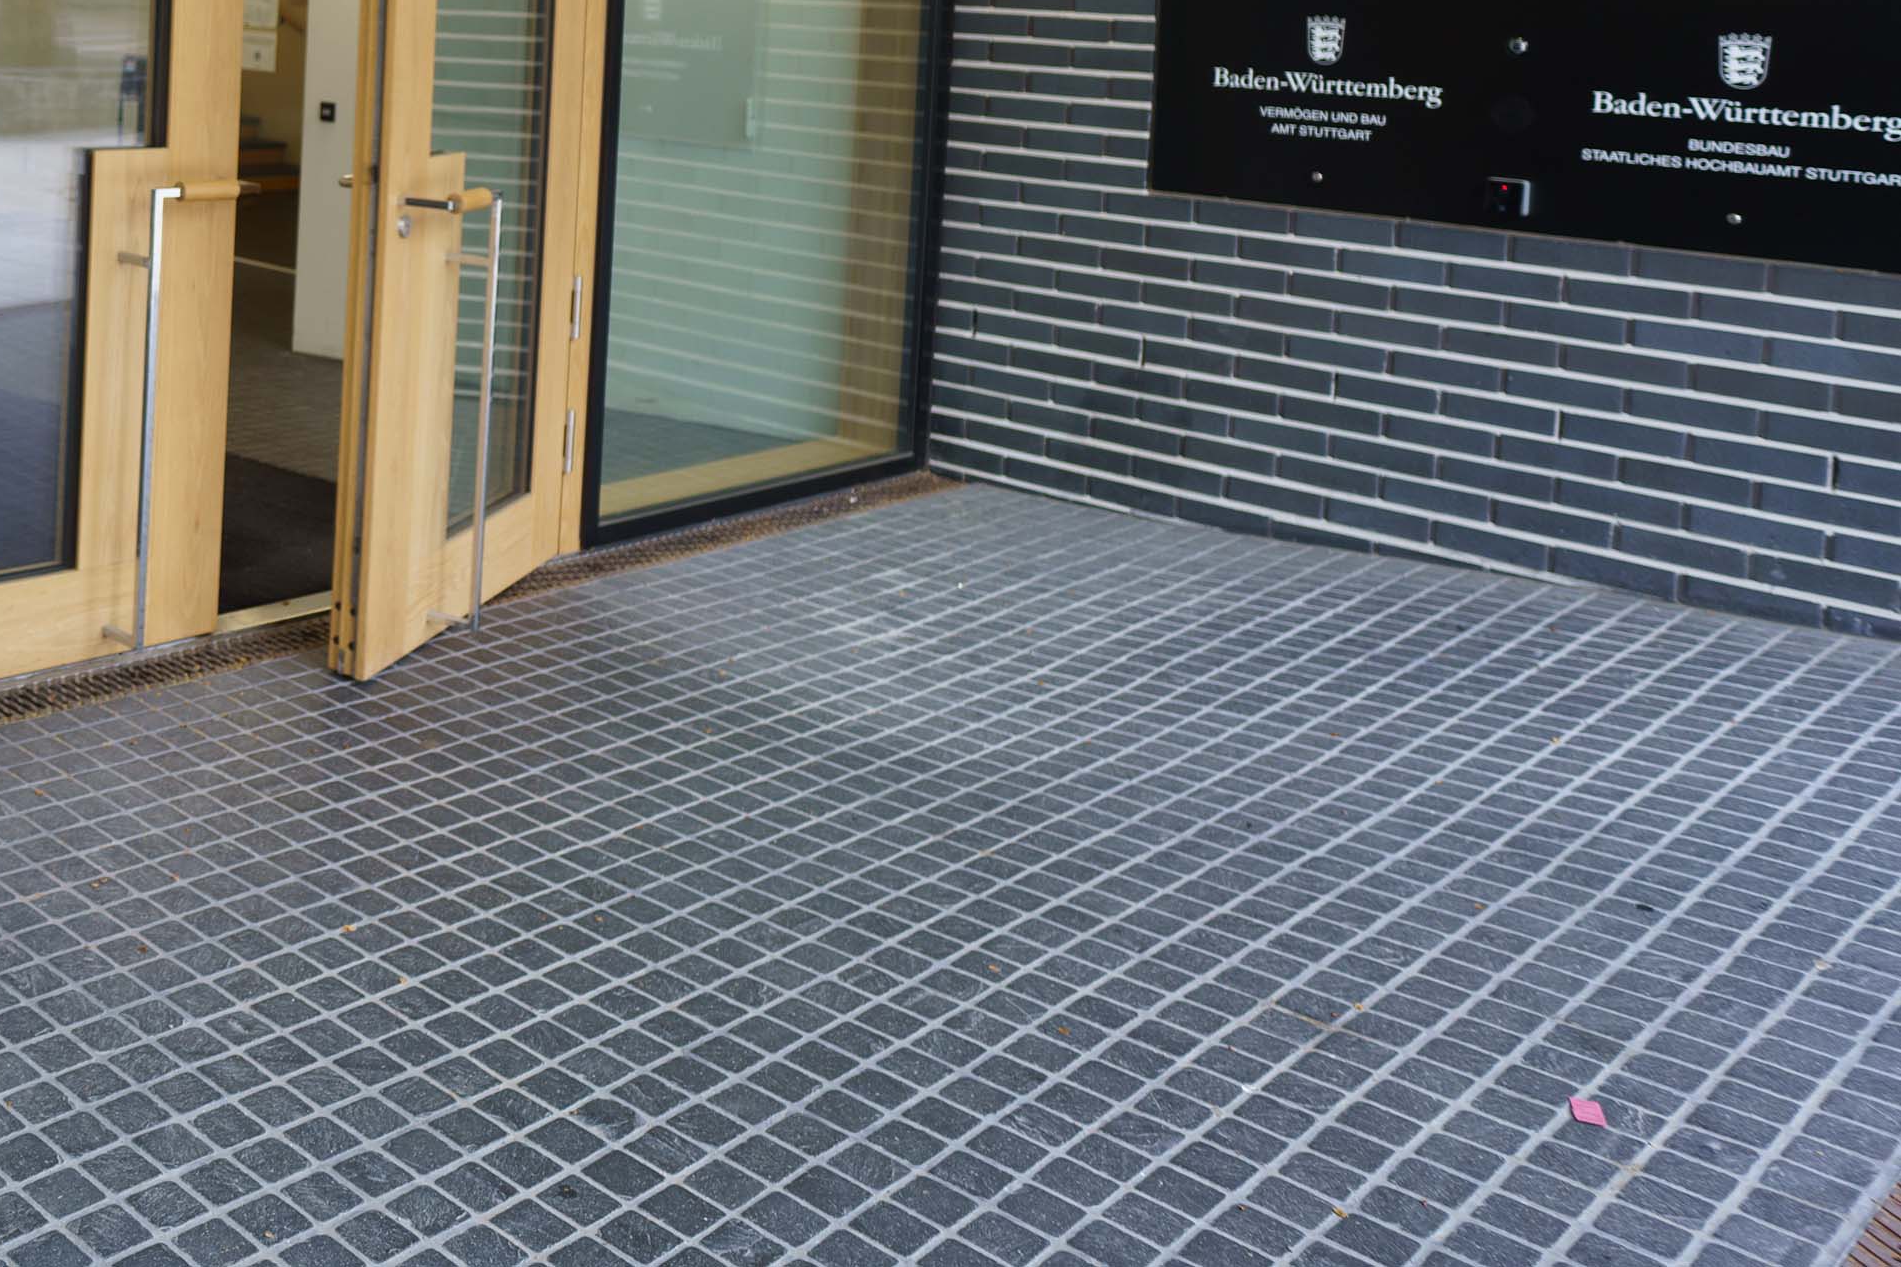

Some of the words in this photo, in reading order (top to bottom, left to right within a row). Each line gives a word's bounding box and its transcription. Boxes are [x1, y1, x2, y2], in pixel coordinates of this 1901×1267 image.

[1213, 66, 1444, 109] Baden-Württemberg
[1259, 105, 1329, 122] VERMÖGEN
[1330, 111, 1359, 125] UND
[1359, 113, 1387, 127] BAU
[1591, 90, 1901, 143] Baden-Württemberg
[1270, 122, 1298, 136] AMT
[1298, 124, 1373, 142] STUTTGART
[1685, 137, 1792, 159] BUNDESBAU
[1581, 147, 1683, 169] STAATLICHES
[1684, 157, 1803, 179] HOCHBAUAMT
